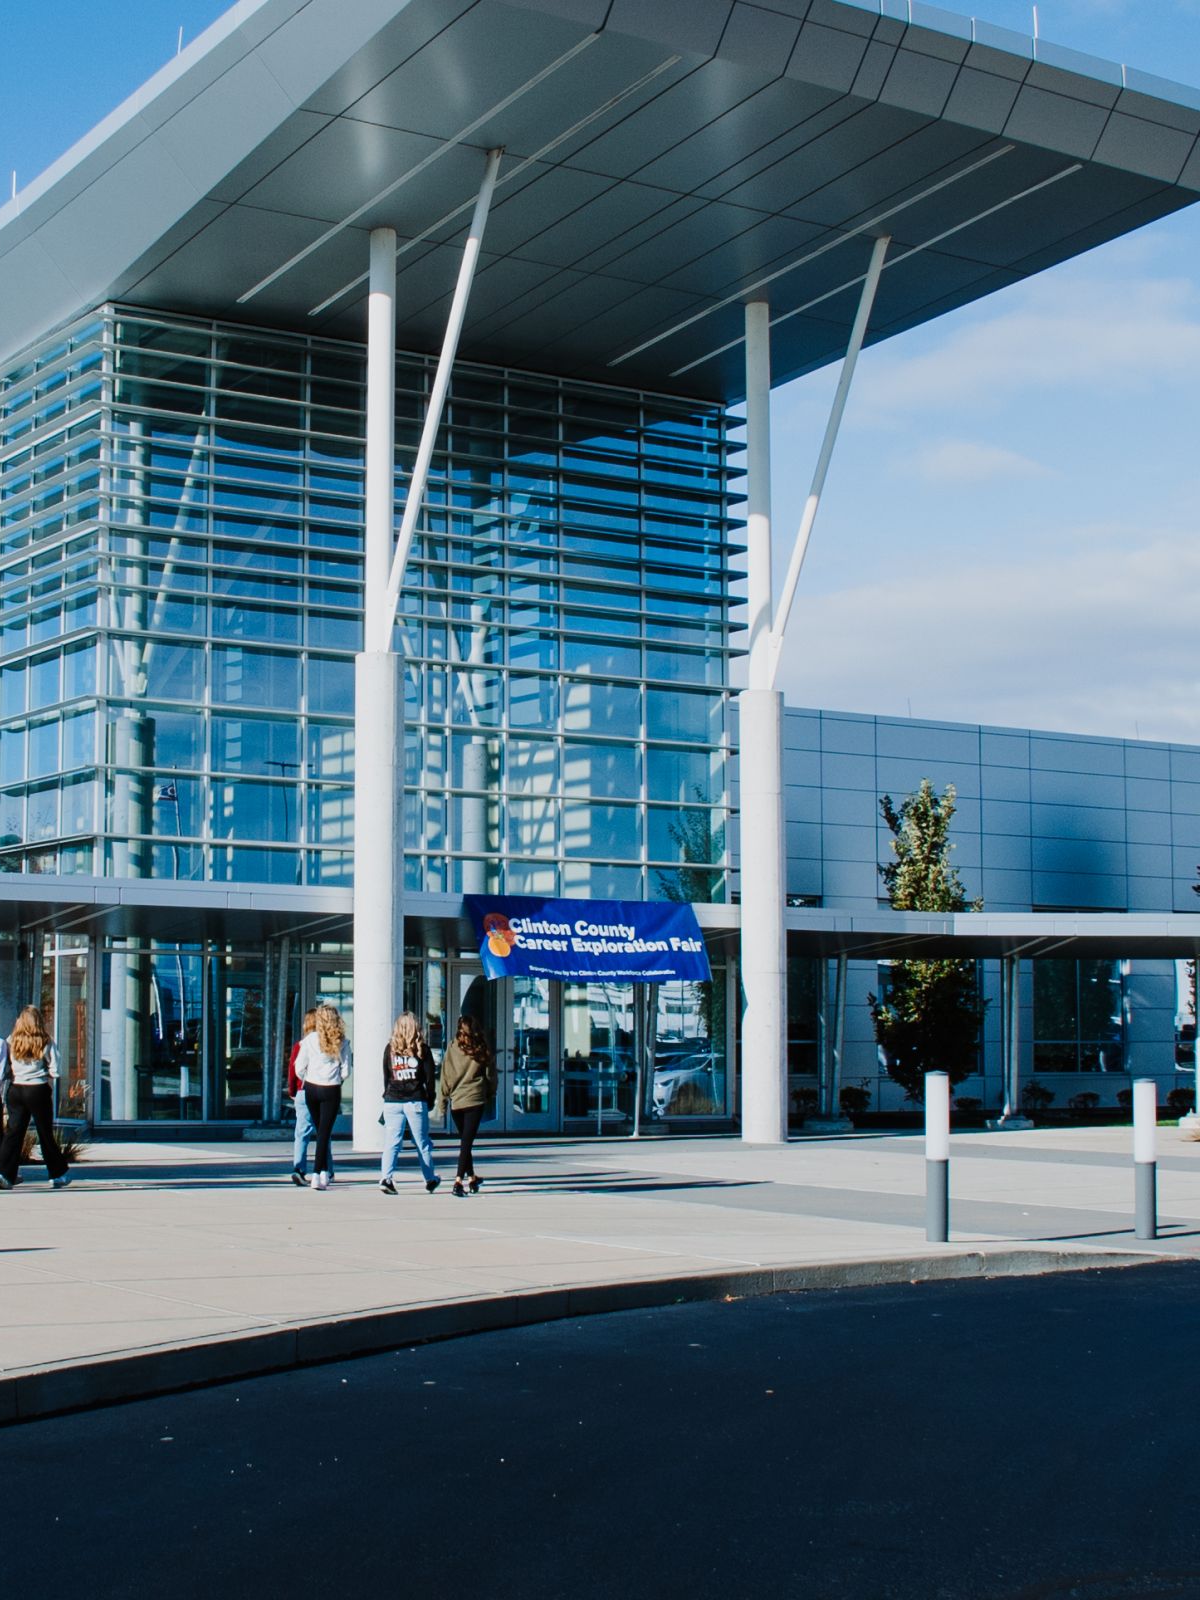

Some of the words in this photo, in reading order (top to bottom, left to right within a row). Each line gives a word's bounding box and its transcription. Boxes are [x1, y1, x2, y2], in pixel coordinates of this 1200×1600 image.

[508, 918, 572, 936] Clinton
[574, 920, 635, 941] County
[514, 935, 568, 952] Career
[571, 937, 669, 956] Exploration
[669, 937, 702, 952] Fair
